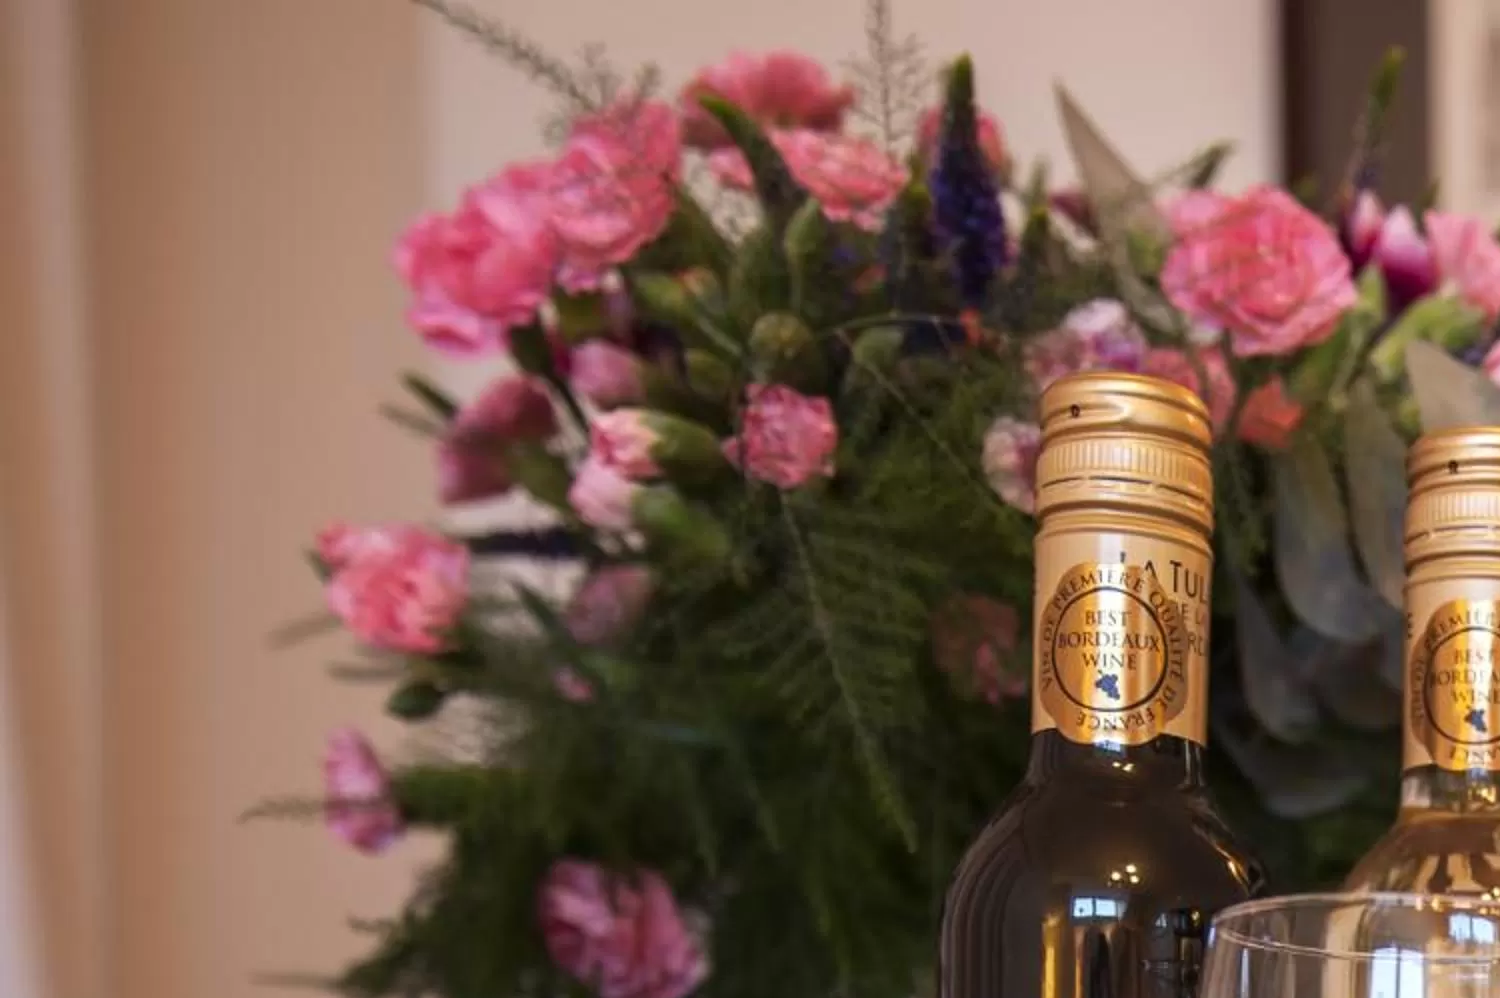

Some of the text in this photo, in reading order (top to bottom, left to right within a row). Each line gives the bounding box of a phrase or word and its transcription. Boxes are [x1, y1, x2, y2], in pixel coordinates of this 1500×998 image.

[1085, 609, 1133, 627] BEST
[1058, 630, 1161, 652] BORDEAUX
[1082, 653, 1138, 670] WINE
